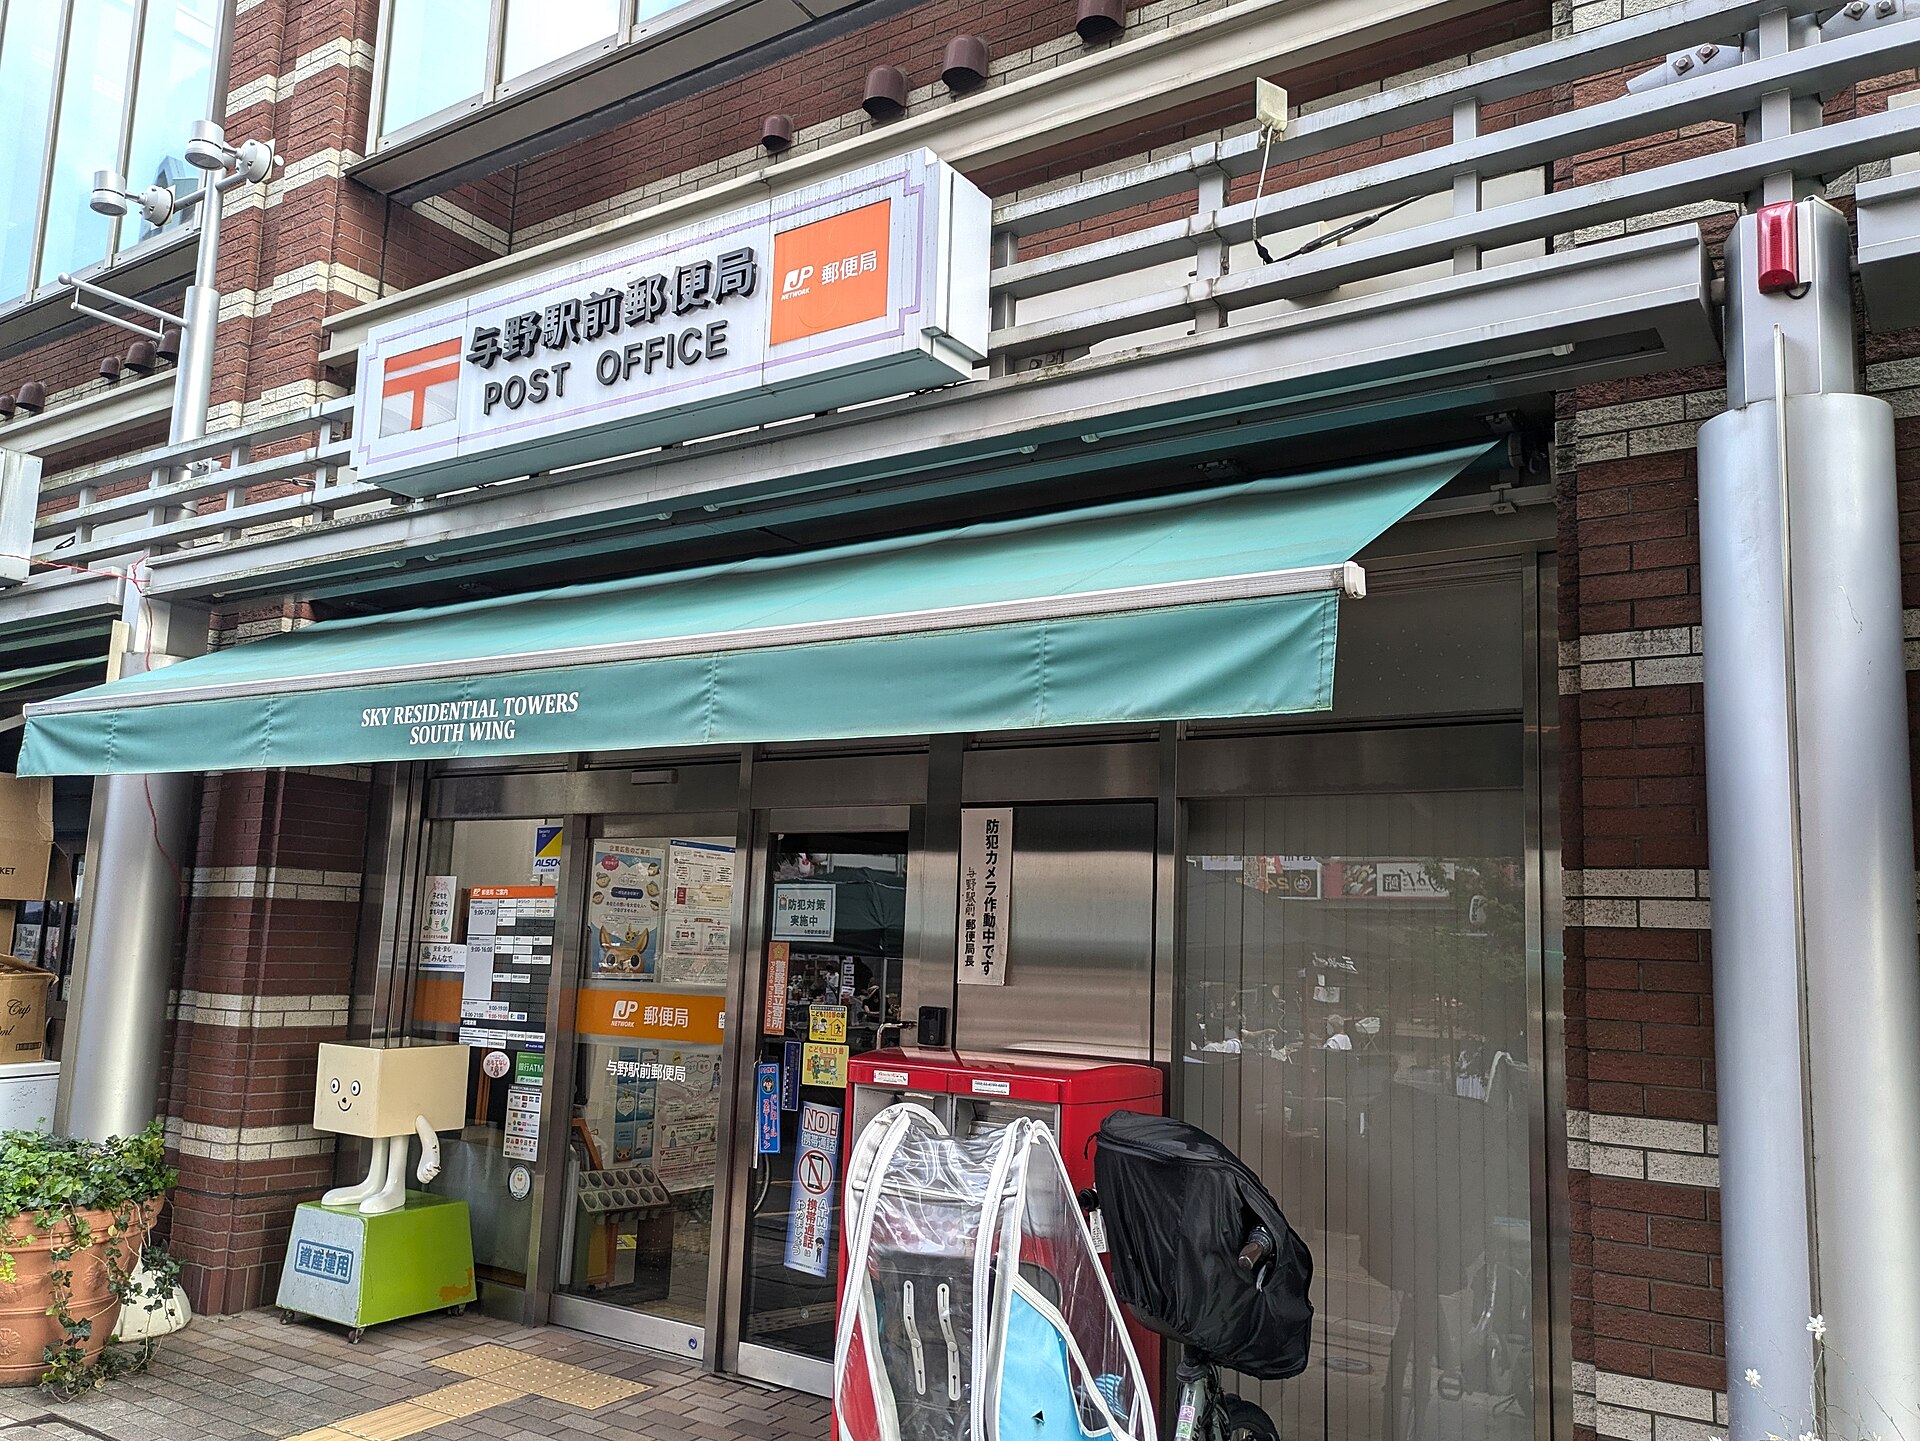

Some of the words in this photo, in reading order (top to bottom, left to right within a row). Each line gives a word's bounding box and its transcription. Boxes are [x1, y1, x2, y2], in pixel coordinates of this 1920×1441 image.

[783, 265, 814, 293] JP
[821, 250, 877, 286] 郵便局
[781, 287, 810, 301] NETWORK
[466, 246, 757, 369] 与野駅前郵便局
[483, 361, 571, 416] POST
[596, 319, 729, 386] OFFICE
[361, 707, 391, 728] SKY
[393, 699, 500, 726] RESIDENTIAL
[503, 691, 579, 717] TOWERS
[409, 723, 465, 745] SOUTH
[469, 720, 516, 741] WING
[788, 898, 826, 911] 防犯対策
[981, 819, 999, 976] 防犯カメラ作動中です
[790, 915, 818, 927] 実施中
[431, 954, 453, 963] みんなで
[7, 999, 31, 1019] Cup
[612, 1000, 638, 1020] JP
[643, 1005, 689, 1028] 郵便局
[610, 1020, 635, 1028] NETWORK
[606, 1060, 686, 1083] 与野駅前郵便局
[803, 1107, 839, 1137] NO!
[802, 1131, 837, 1153] 携帯通話
[298, 1245, 350, 1278] 資産運用
